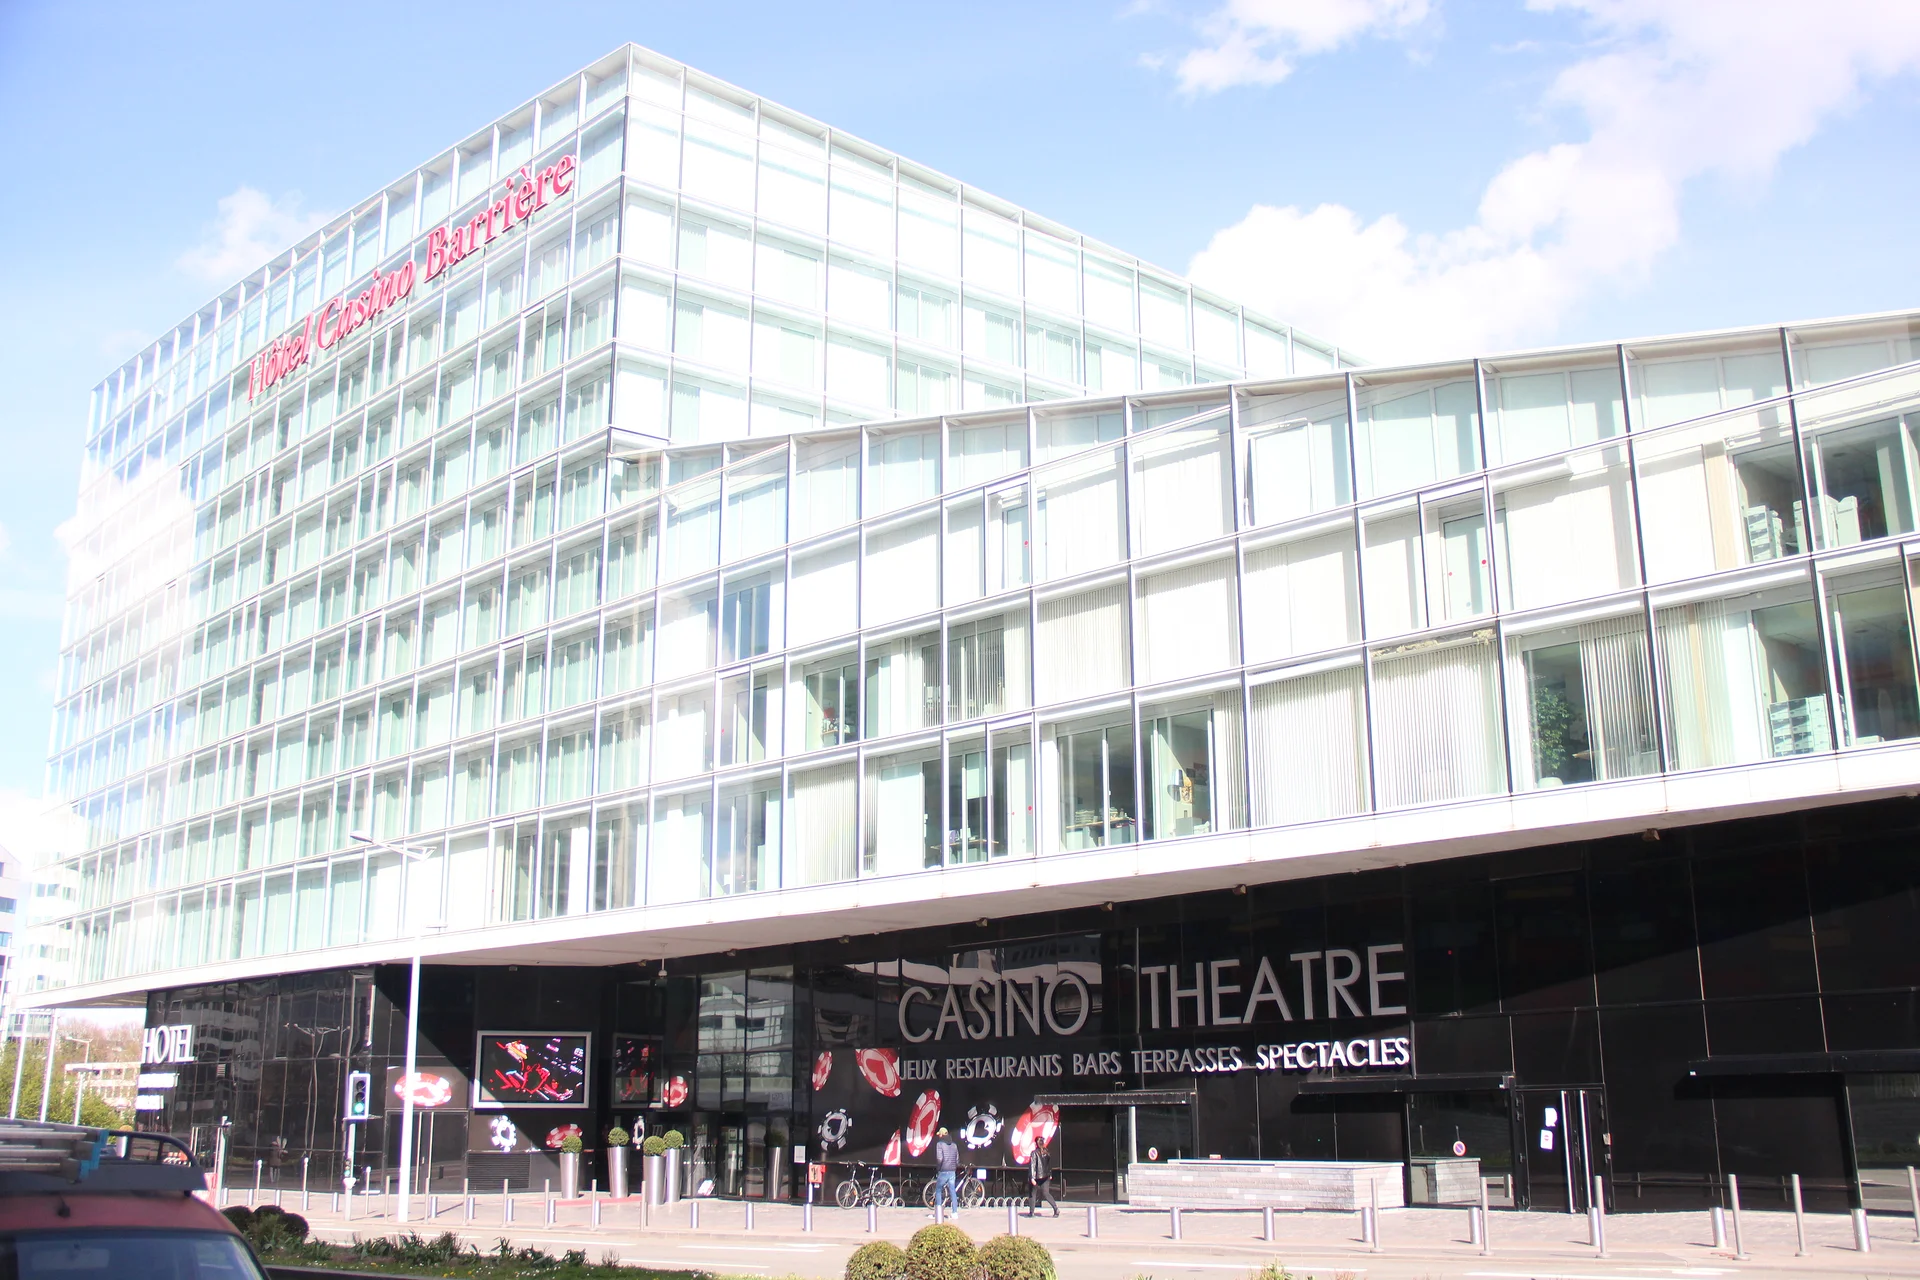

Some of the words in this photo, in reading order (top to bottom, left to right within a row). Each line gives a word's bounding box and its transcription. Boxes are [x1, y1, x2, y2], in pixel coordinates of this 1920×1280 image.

[248, 313, 313, 402] Hôtel
[316, 260, 417, 350] Casino
[424, 154, 577, 283] Barrière
[899, 972, 1090, 1043] CASINO
[1141, 943, 1407, 1029] THEATRE
[141, 1024, 195, 1064] HOTEL
[900, 1059, 937, 1081] JEUX
[945, 1053, 1063, 1080] RESTAURANTS
[1072, 1051, 1122, 1076] BARS
[1131, 1046, 1242, 1073] TERRASSES
[1256, 1037, 1411, 1070] SPECTACLES
